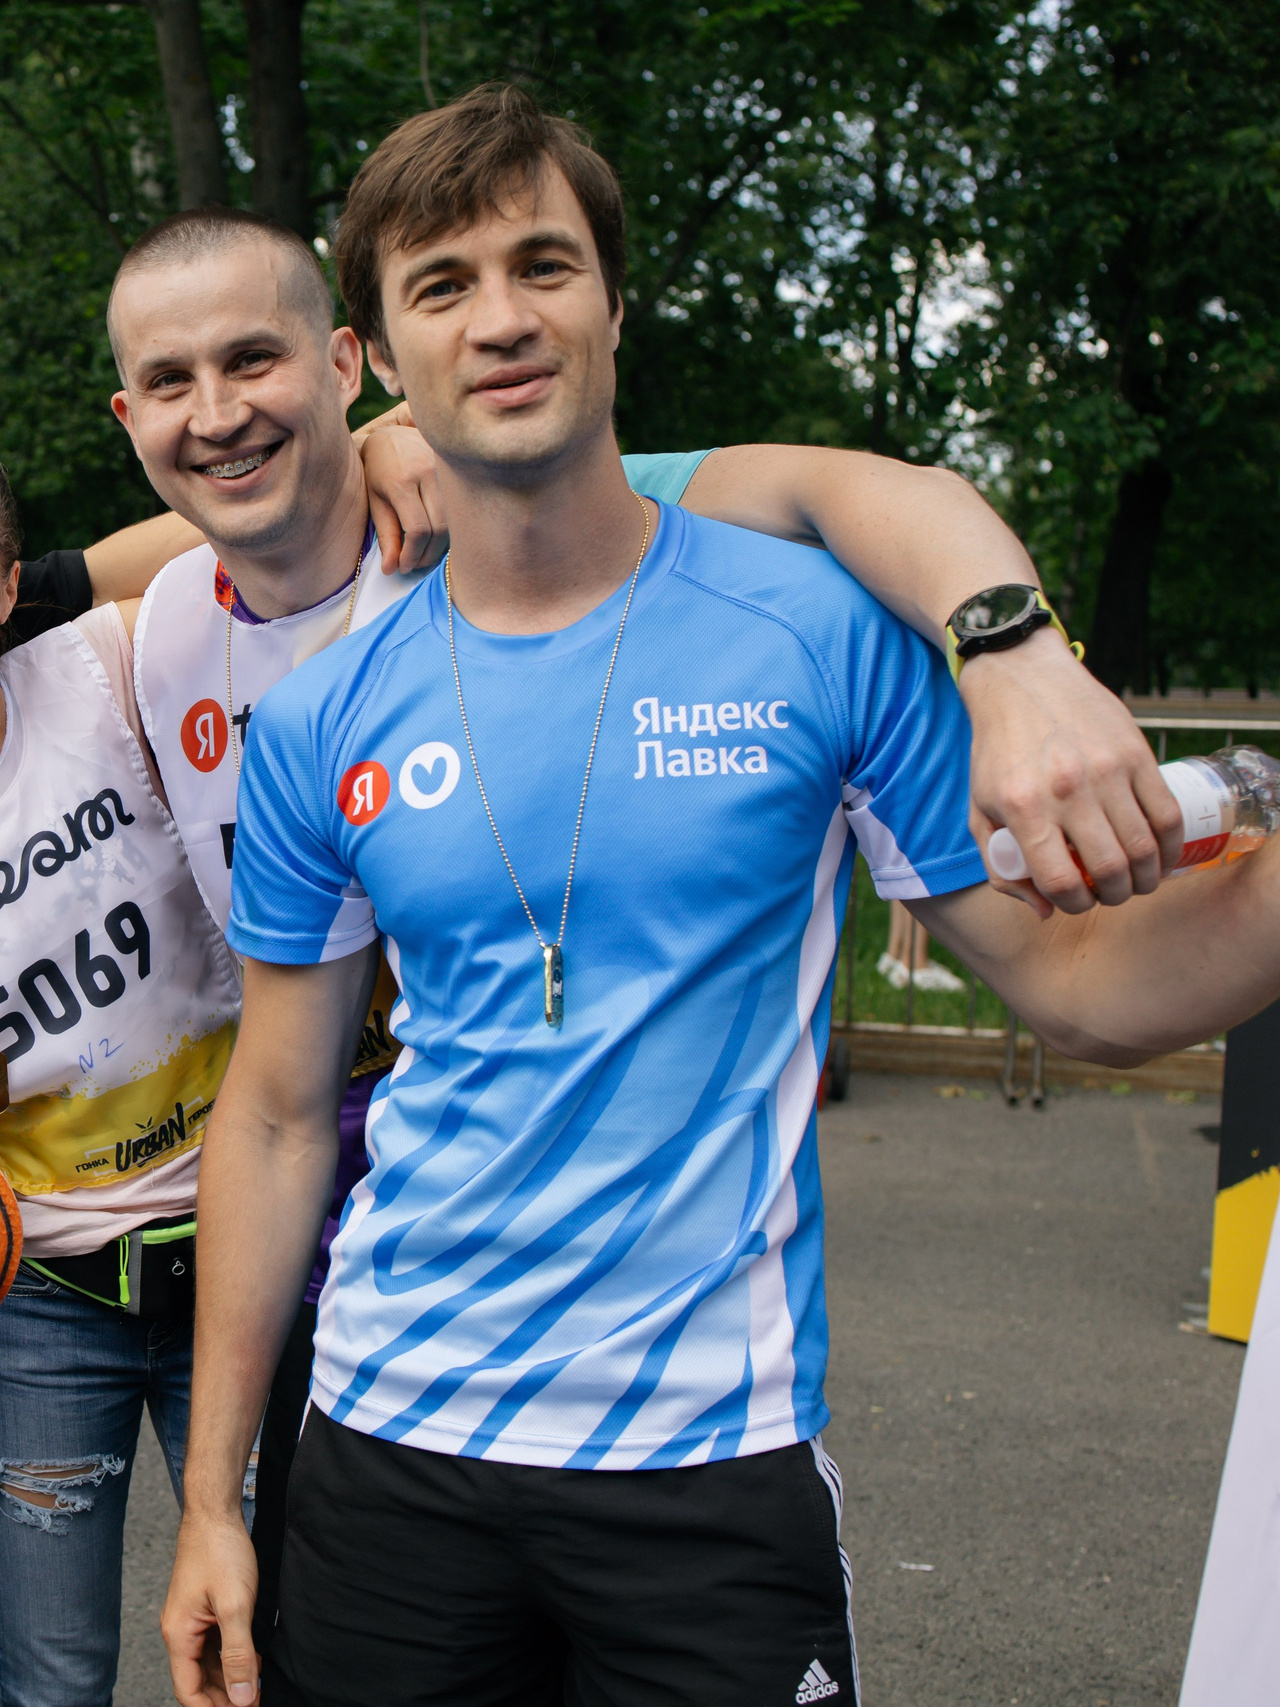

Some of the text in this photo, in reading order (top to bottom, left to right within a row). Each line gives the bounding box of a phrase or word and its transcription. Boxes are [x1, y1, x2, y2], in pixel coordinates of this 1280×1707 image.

[633, 697, 790, 738] Яндекс
[634, 740, 768, 780] Лавка
[75, 1157, 110, 1173] ГОНКА
[115, 1102, 187, 1172] URBAN
[795, 1681, 839, 1704] adidas
